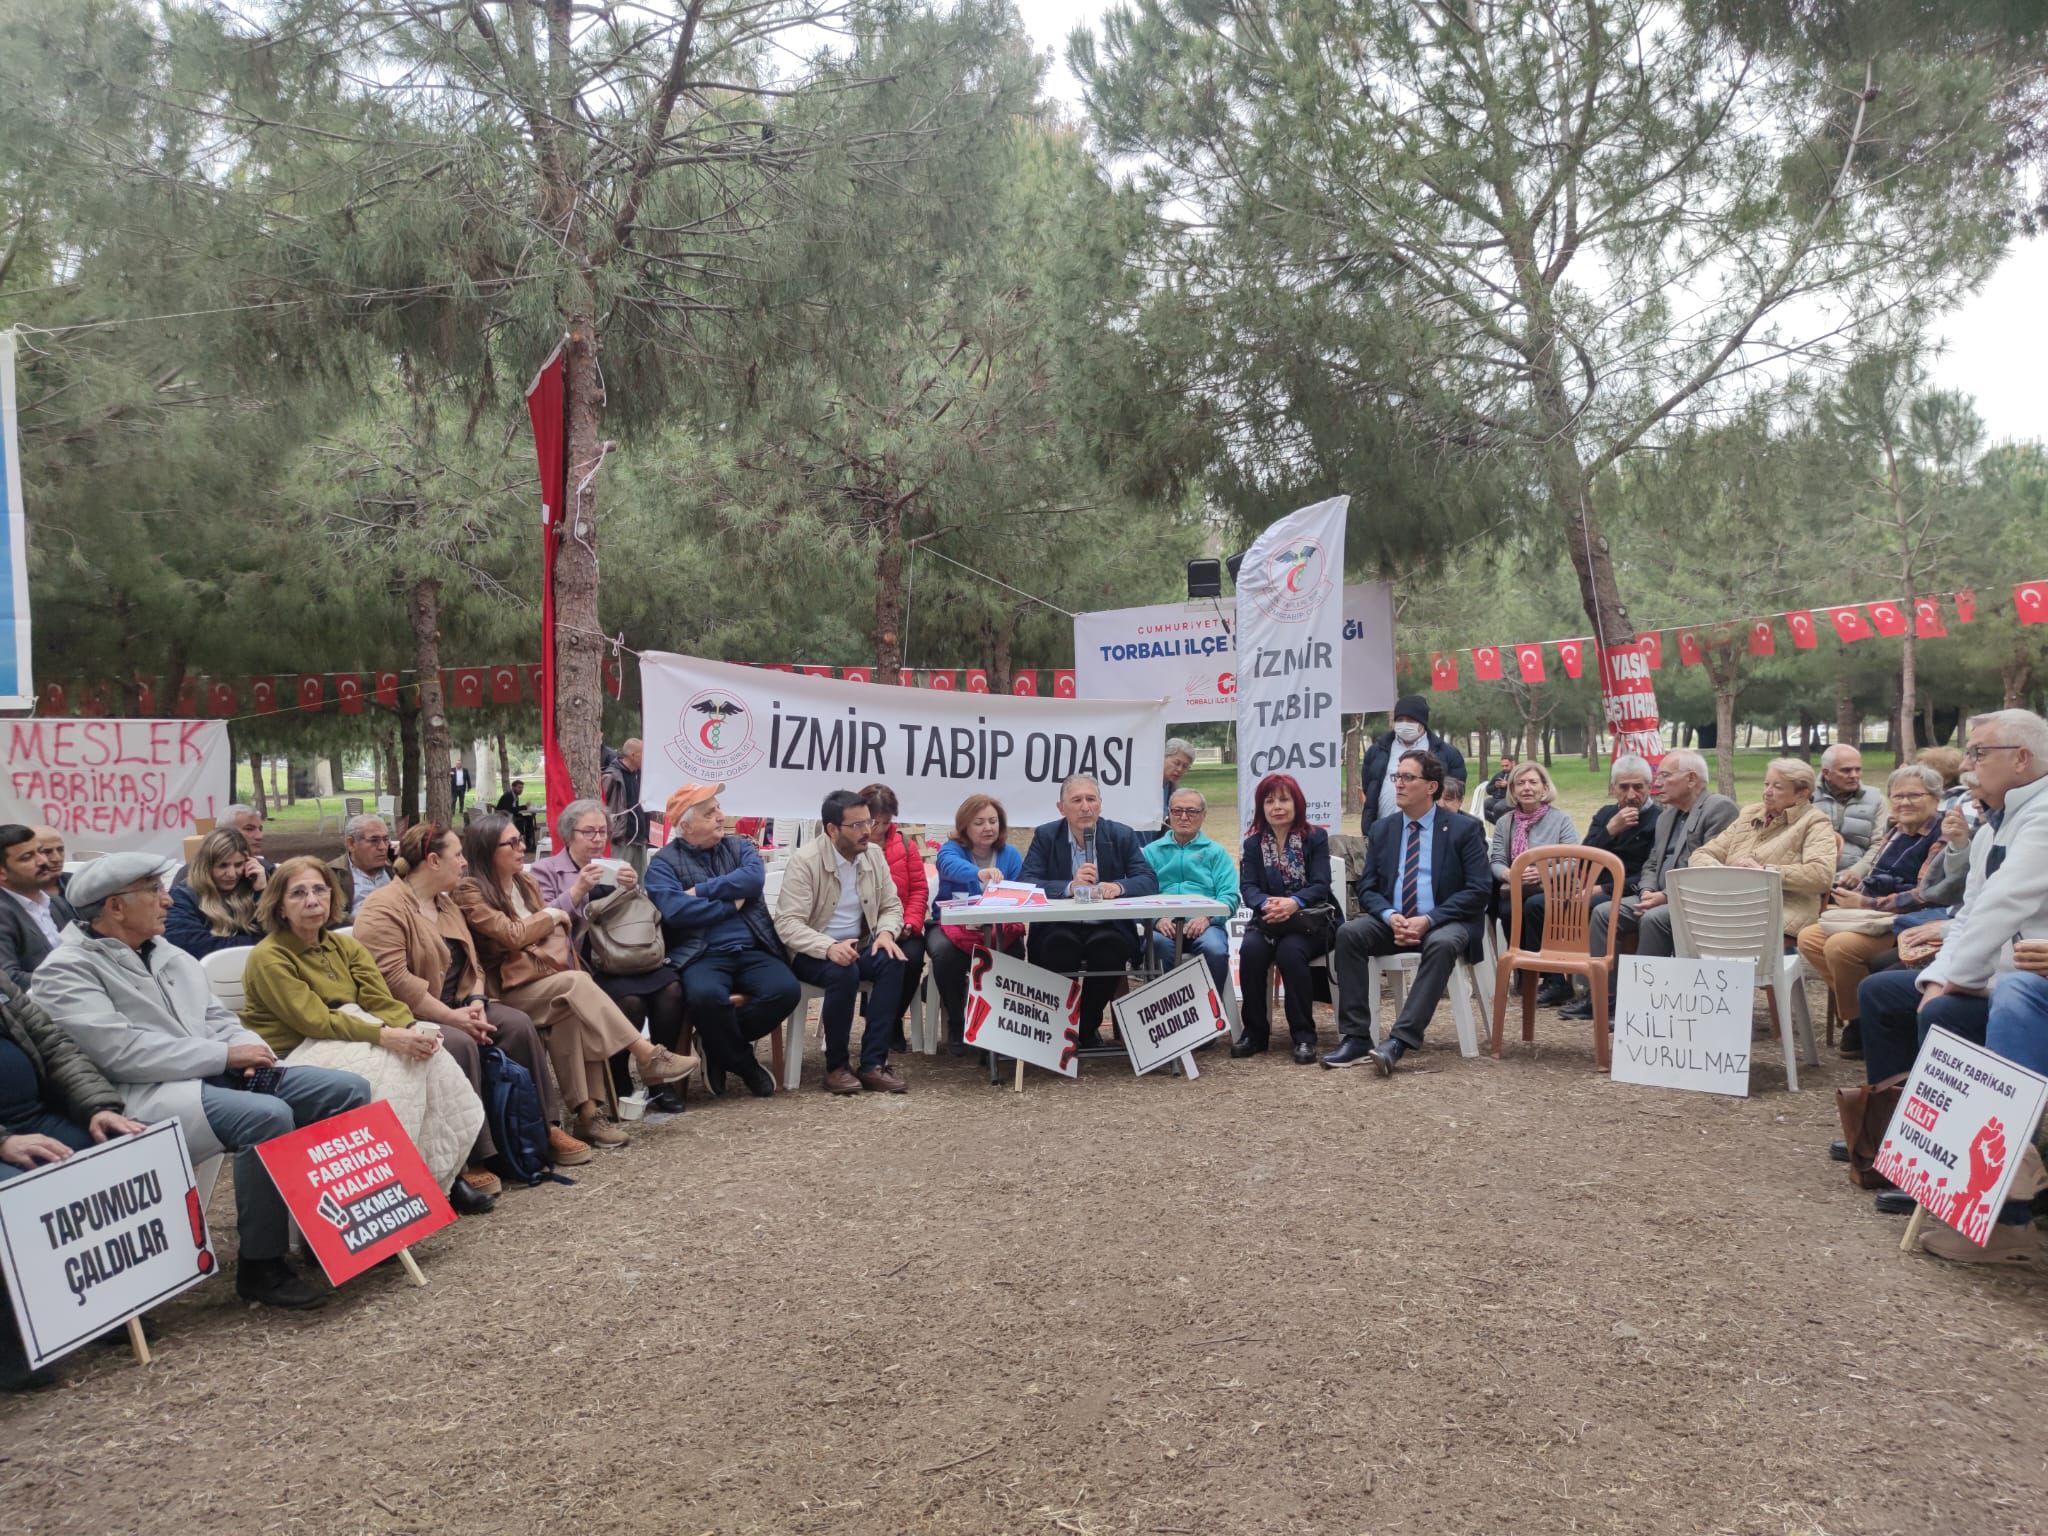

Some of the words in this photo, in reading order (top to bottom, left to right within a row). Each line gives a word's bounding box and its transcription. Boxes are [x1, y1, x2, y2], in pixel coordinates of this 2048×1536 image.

[1137, 619, 1218, 634] CUMHURİYET
[1100, 639, 1180, 661] TORBALI
[1184, 636, 1228, 657] İLÇE
[1254, 636, 1332, 678] İZMİR
[1187, 697, 1213, 705] TORBALI
[1253, 686, 1333, 727] TABİP
[7, 721, 210, 768] MESLEK
[768, 701, 886, 774] İZMİR
[899, 716, 1014, 780] TABİP
[1024, 732, 1133, 786] ODASI
[1250, 742, 1337, 777] ODASI
[11, 768, 165, 803] FABRİKASI
[995, 975, 1060, 1013] SATILMAMIŞ
[1003, 997, 1050, 1024] FABRİKA
[1137, 983, 1195, 1025] TAPUMUZU
[1651, 993, 1731, 1015] UMUDA
[998, 1016, 1032, 1038] KALDI
[1034, 1027, 1052, 1044] MI?
[1149, 1006, 1199, 1048] ÇALDILAR
[1626, 1011, 1697, 1042] KİLİT
[1626, 1045, 1749, 1074] VURULMAZ
[1930, 1046, 1964, 1072] MESLEK
[1963, 1063, 2016, 1099] FABRİKASI
[1915, 1081, 1952, 1112] EMEĞE
[1923, 1062, 1970, 1098] KAPANMAZ,
[1906, 1100, 1937, 1128] KİLİT
[307, 1126, 375, 1164] MESLEK
[307, 1140, 394, 1188] FABRİKASI
[1899, 1121, 1958, 1171] VURULMAZ
[331, 1162, 394, 1201] HALKIN
[39, 1168, 162, 1250] TAPUMUZU
[350, 1183, 408, 1222] EKMEK
[343, 1196, 429, 1250] KAPISIDIR!
[64, 1217, 168, 1306] ÇALDILAR
